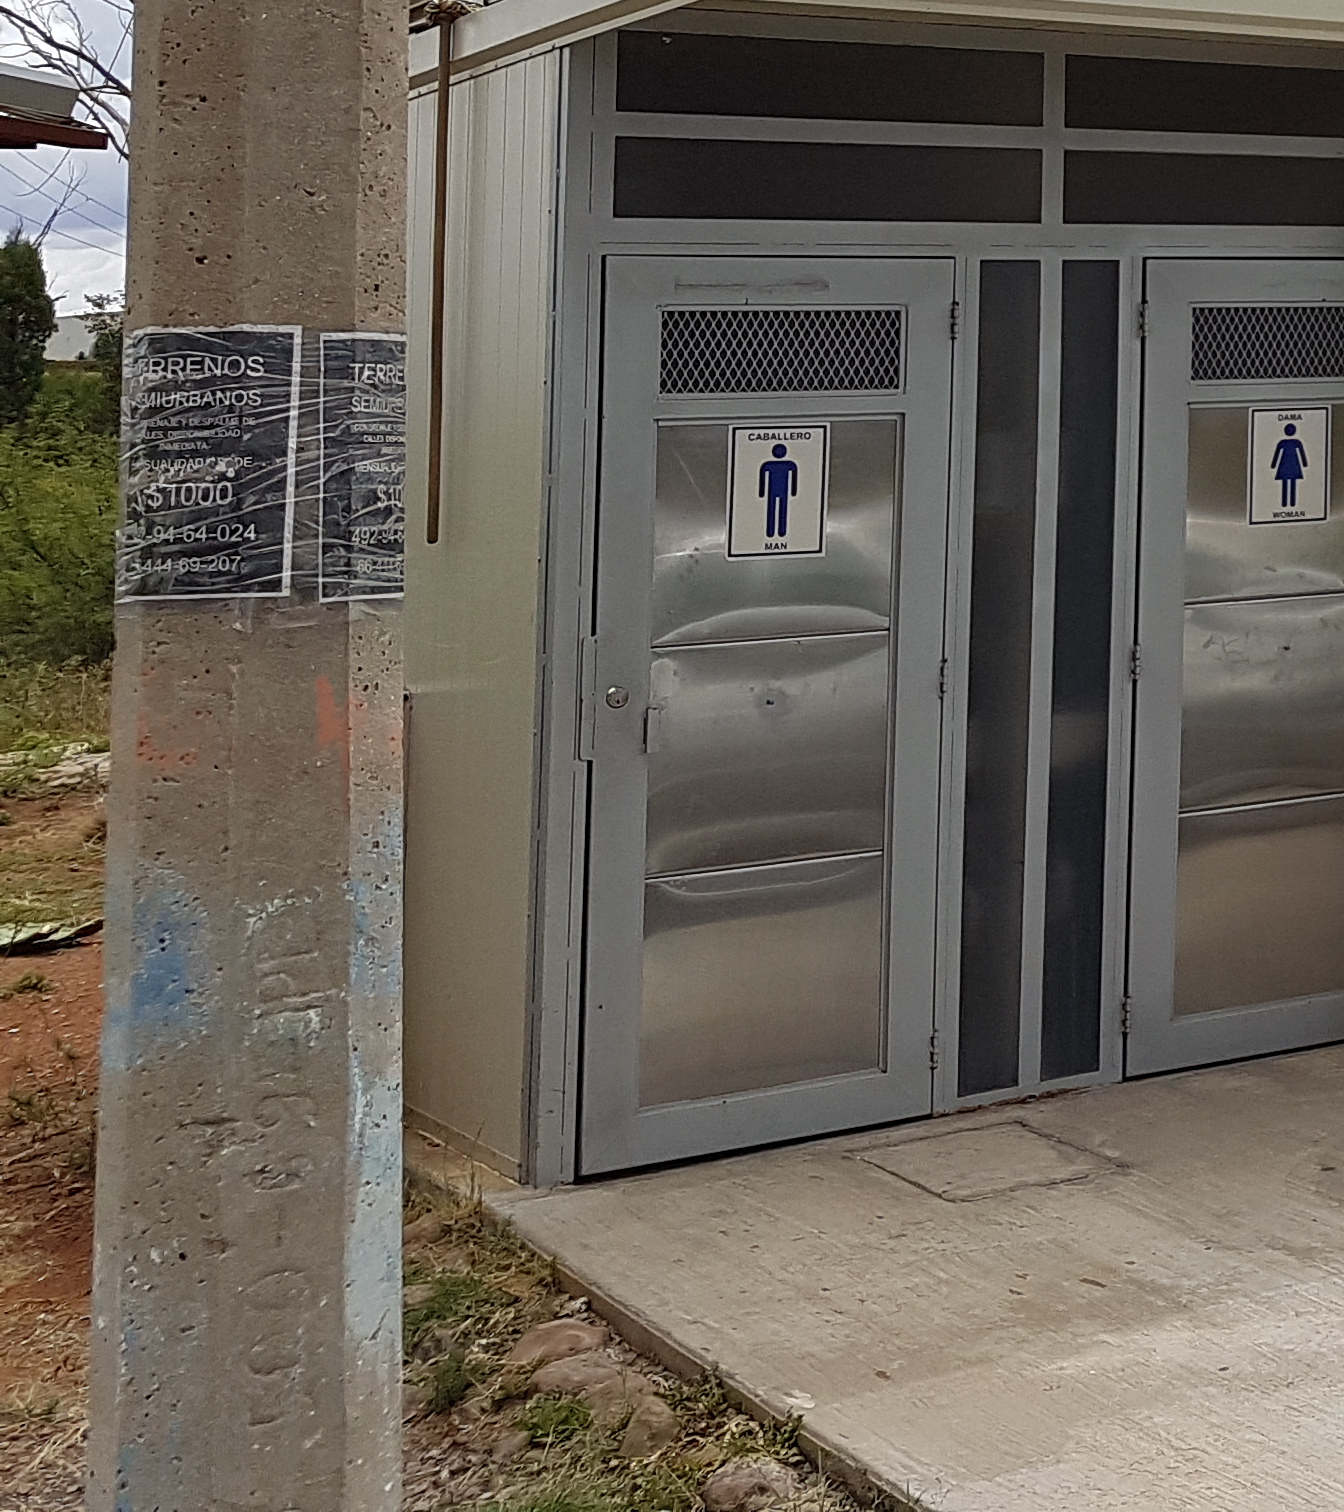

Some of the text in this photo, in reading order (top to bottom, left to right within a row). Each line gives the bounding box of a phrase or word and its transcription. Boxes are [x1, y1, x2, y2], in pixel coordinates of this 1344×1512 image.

[1277, 413, 1303, 422] DAMA
[748, 431, 812, 442] CABALLERO
[147, 481, 233, 509] $1000
[1272, 510, 1306, 519] WOMAN
[764, 541, 788, 551] MAN
